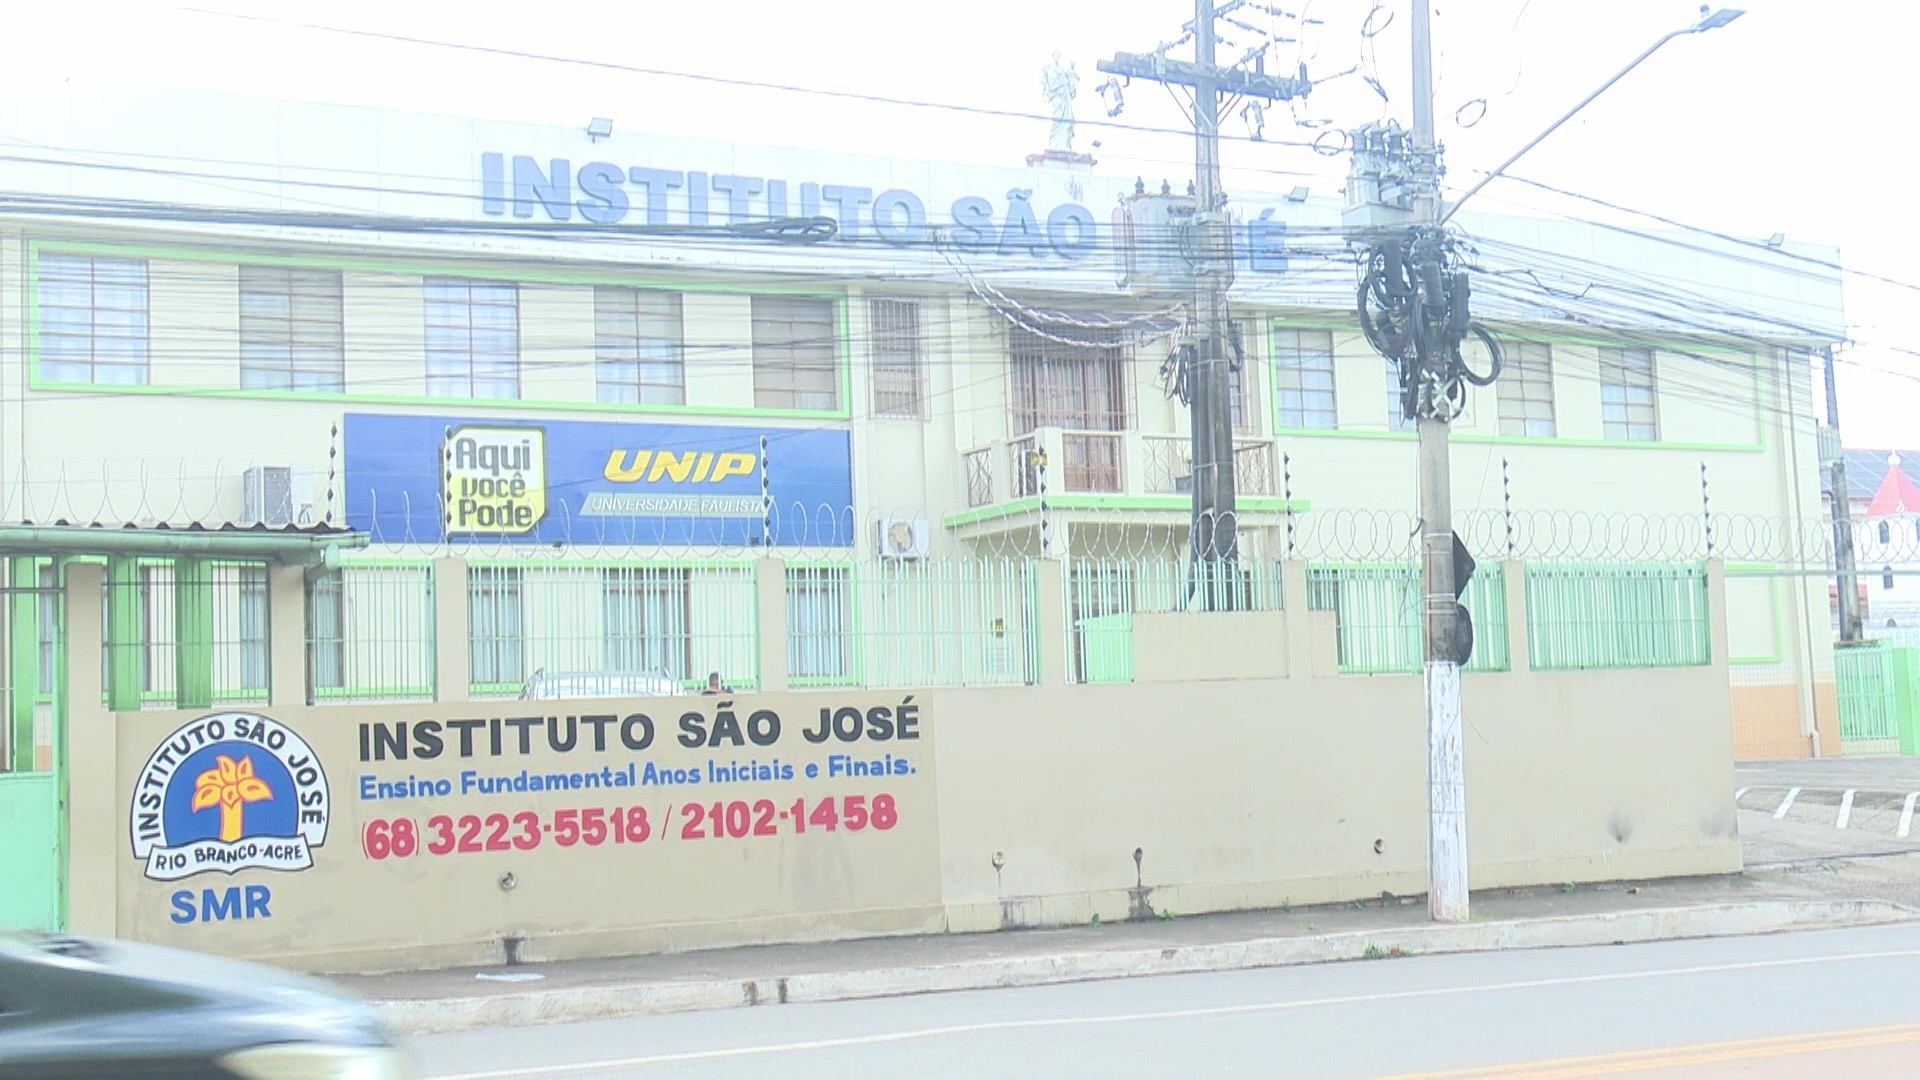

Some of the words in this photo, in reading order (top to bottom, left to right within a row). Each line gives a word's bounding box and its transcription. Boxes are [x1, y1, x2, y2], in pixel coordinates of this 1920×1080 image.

[482, 152, 926, 247] INSTITUTO
[951, 188, 1097, 259] SÃO
[455, 437, 530, 476] Aqui
[604, 449, 757, 483] UNIP
[461, 471, 526, 498] você
[591, 496, 698, 512] UNIVERSIDADE
[459, 499, 532, 527] Pode
[359, 713, 655, 761] INSTITUTO
[677, 701, 781, 748] SÃO
[802, 695, 920, 743] JOSÉ
[138, 719, 225, 841] INSTITUTO
[234, 717, 286, 750] SÃO
[288, 754, 325, 825] JOSÉ
[360, 775, 451, 800] Ensino
[461, 763, 635, 795] Fundamental
[642, 761, 700, 786] Anos
[708, 758, 794, 783] Iniciais
[805, 763, 818, 778] e
[828, 753, 917, 777] Finais.
[362, 818, 420, 860] (68)
[427, 806, 650, 855] 3223-5518
[661, 804, 672, 841] /
[681, 793, 898, 840] 2102-1458
[155, 854, 187, 871] RIO
[170, 884, 272, 924] SMR
